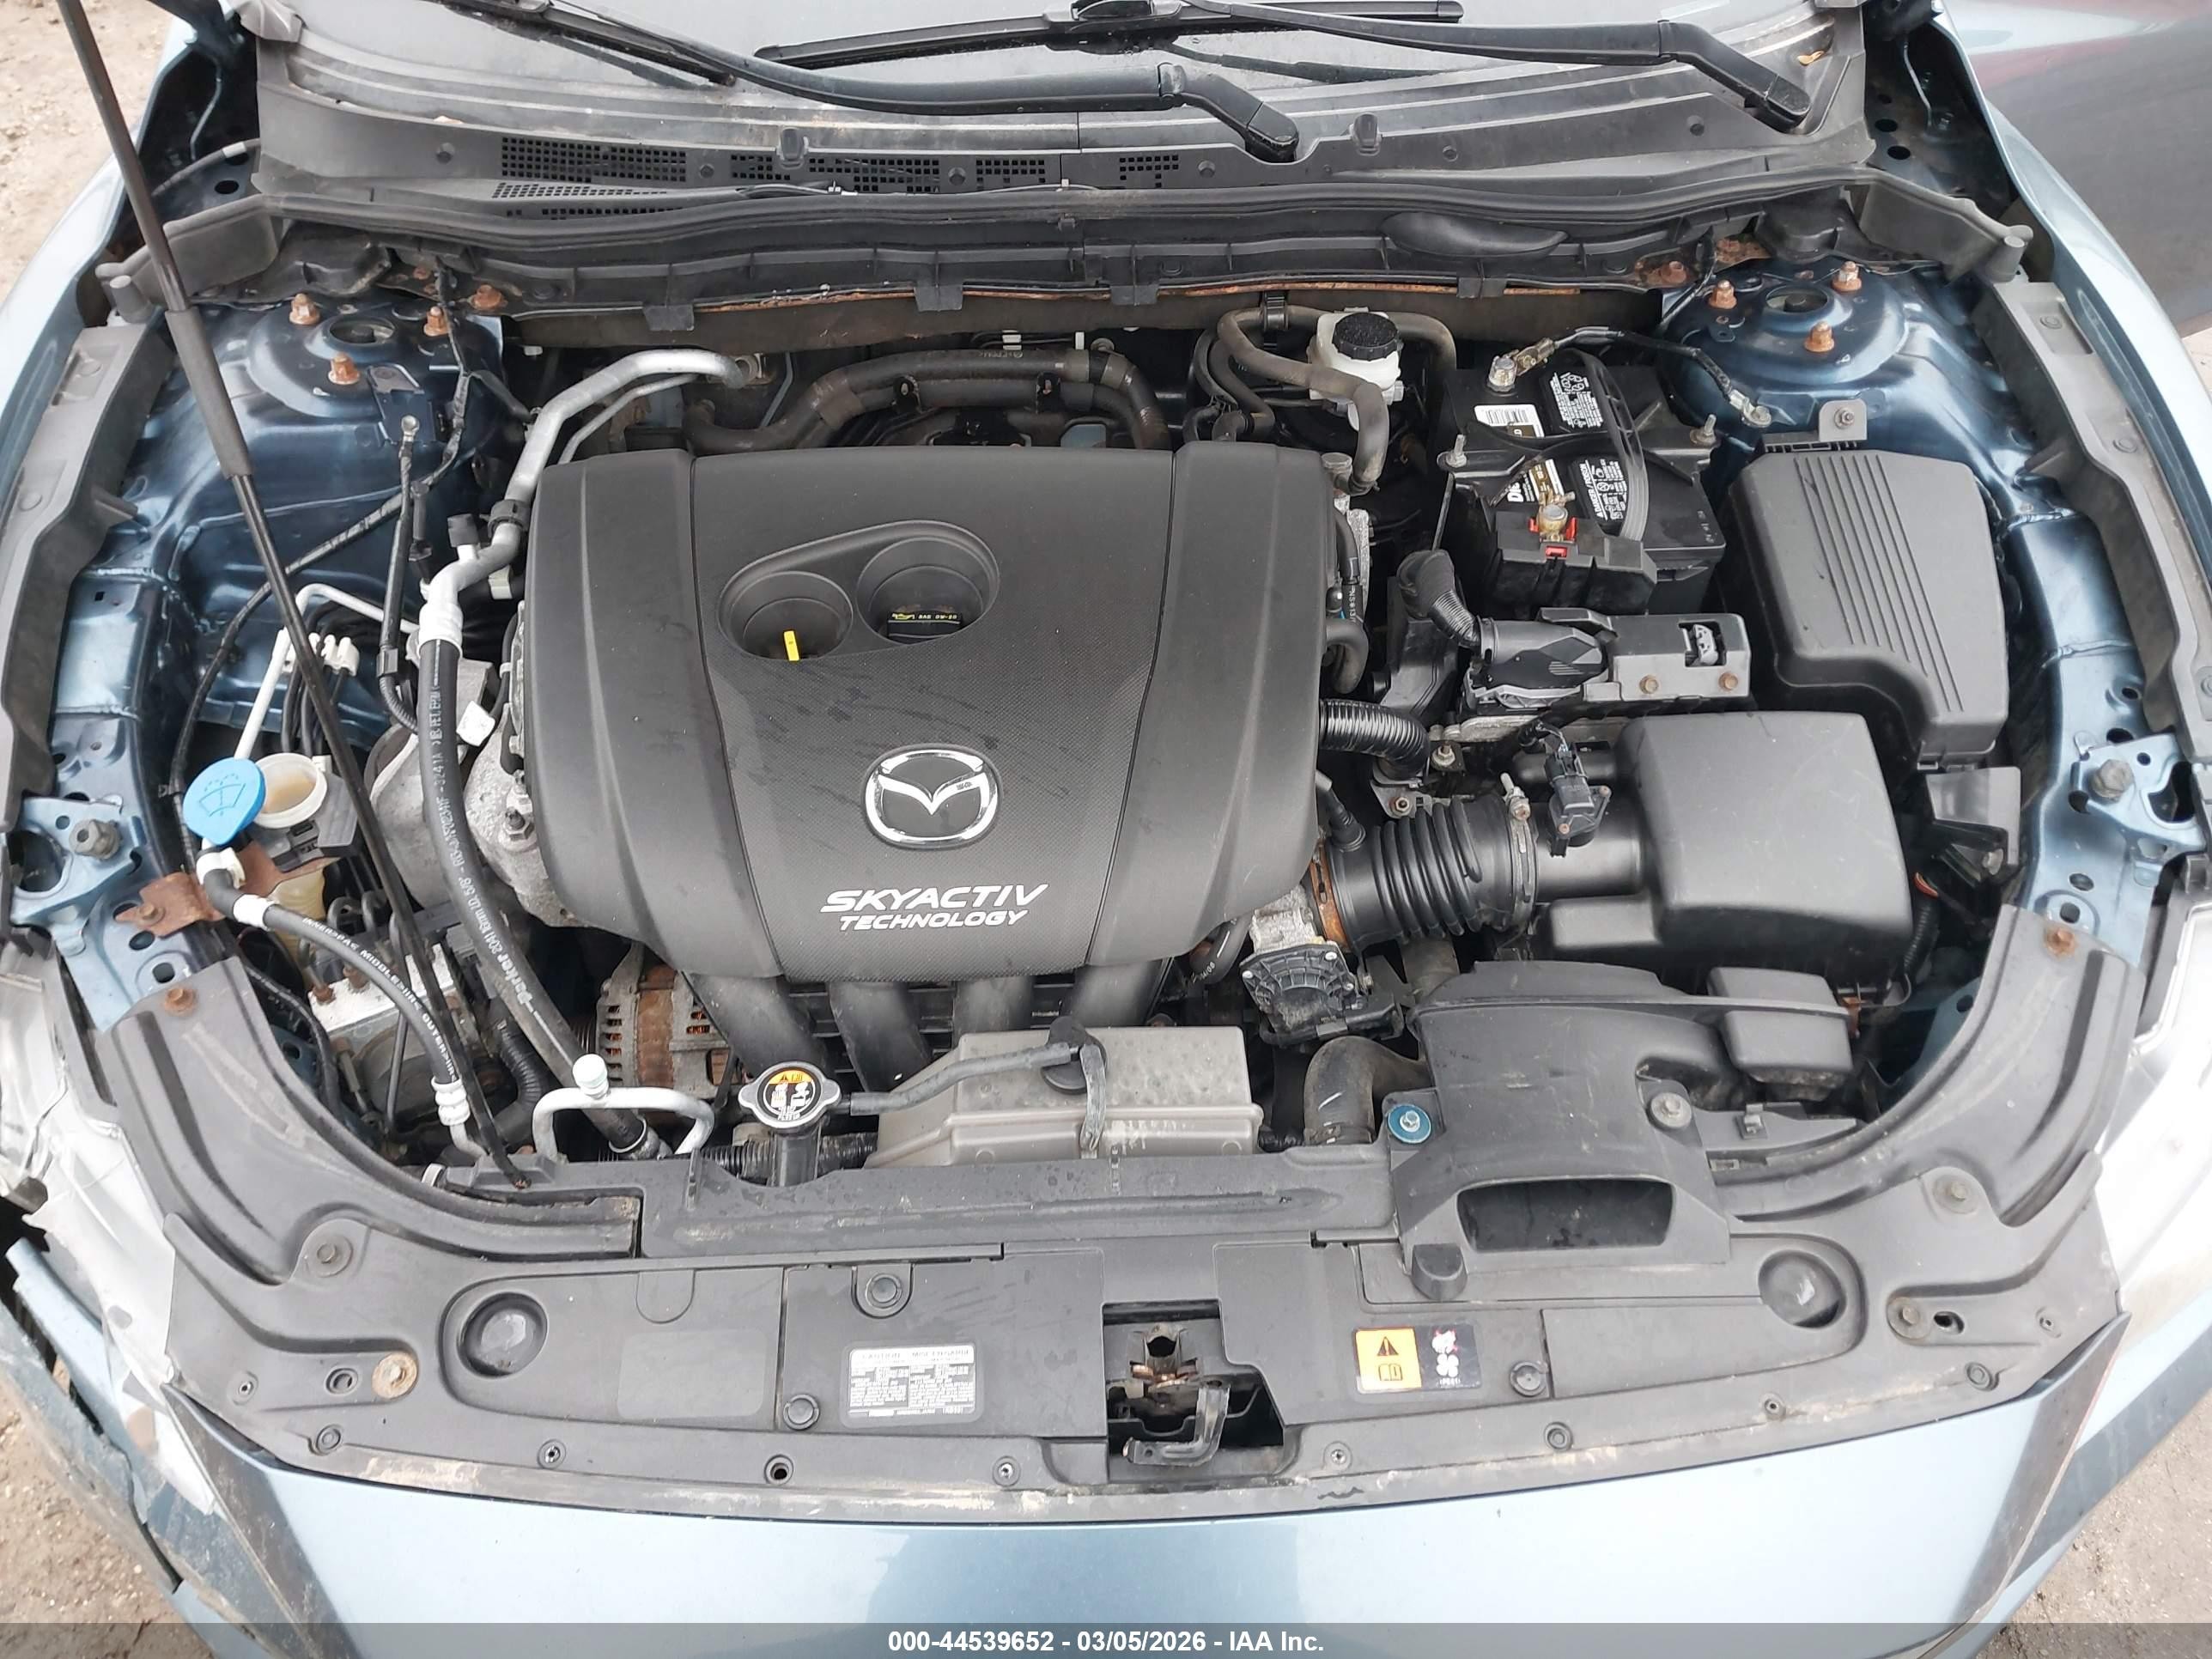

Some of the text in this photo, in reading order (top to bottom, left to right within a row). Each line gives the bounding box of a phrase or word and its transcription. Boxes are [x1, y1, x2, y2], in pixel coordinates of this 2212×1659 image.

[820, 884, 1049, 913] SKYACTIV
[839, 909, 1029, 932] TECHNOLOGY
[497, 953, 533, 1005] Parker
